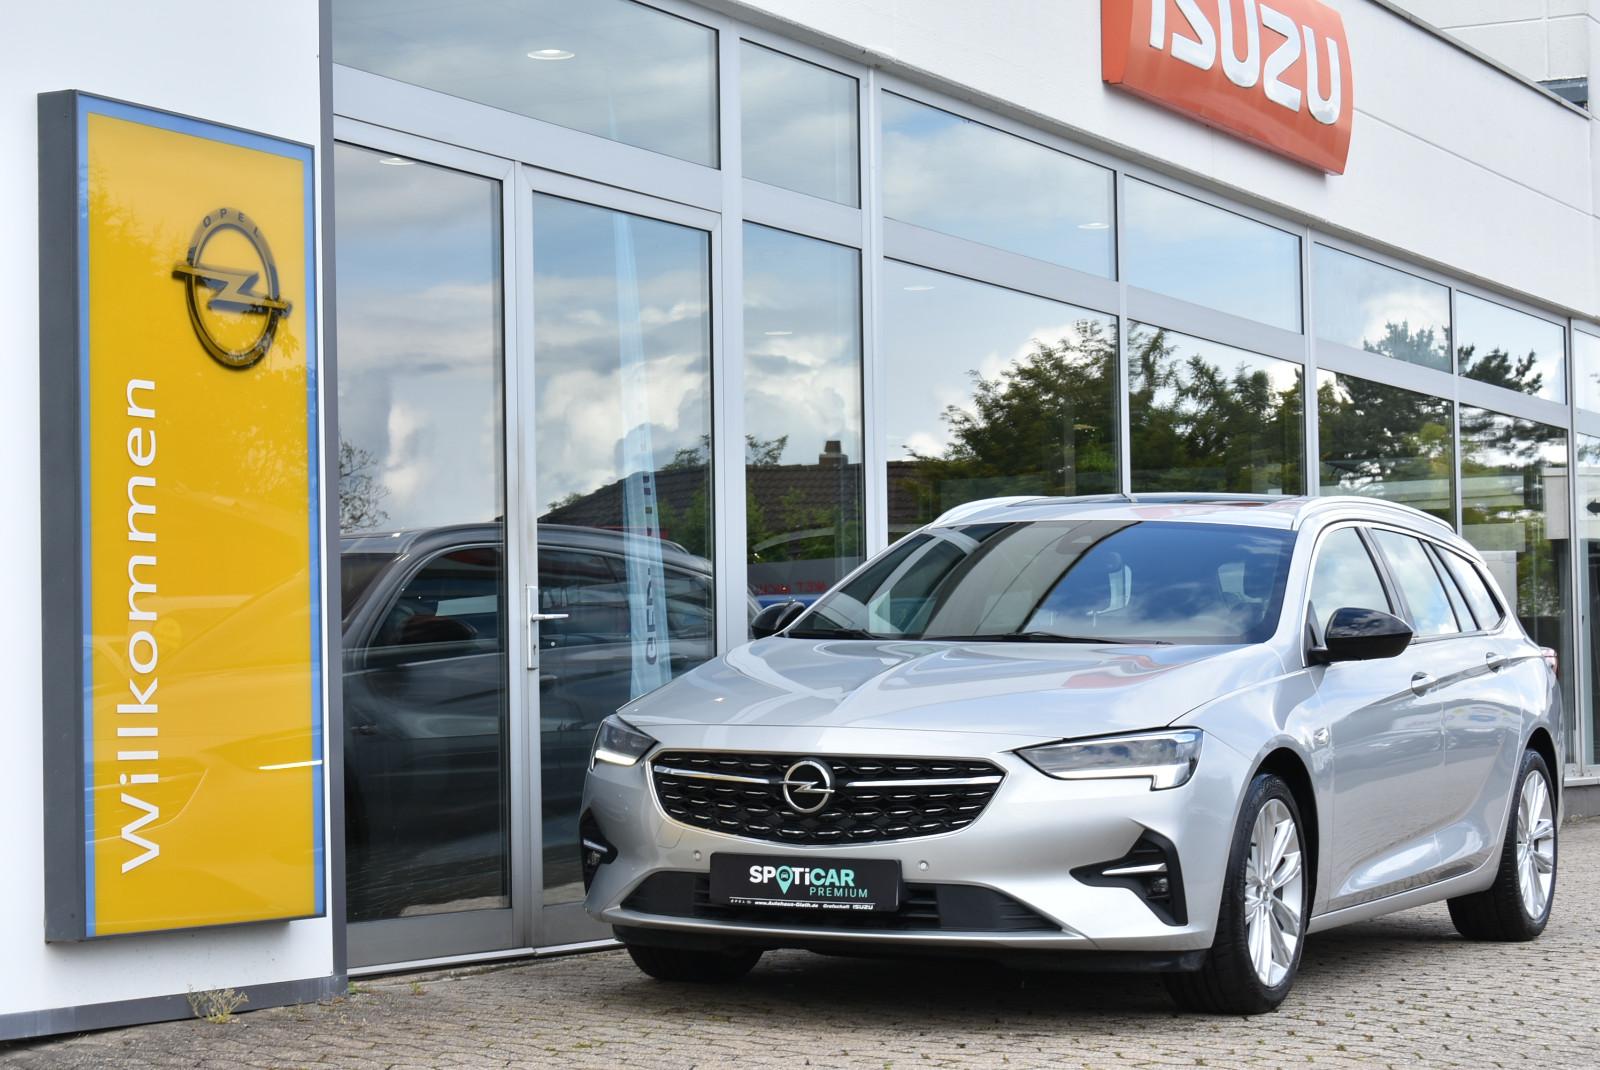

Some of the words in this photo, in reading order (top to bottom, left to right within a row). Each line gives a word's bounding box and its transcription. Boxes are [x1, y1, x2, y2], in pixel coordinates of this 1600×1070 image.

[1149, 0, 1341, 125] ISUZU
[203, 208, 259, 238] OPEL
[116, 377, 160, 874] Willkommen
[809, 887, 868, 898] PREMIUM
